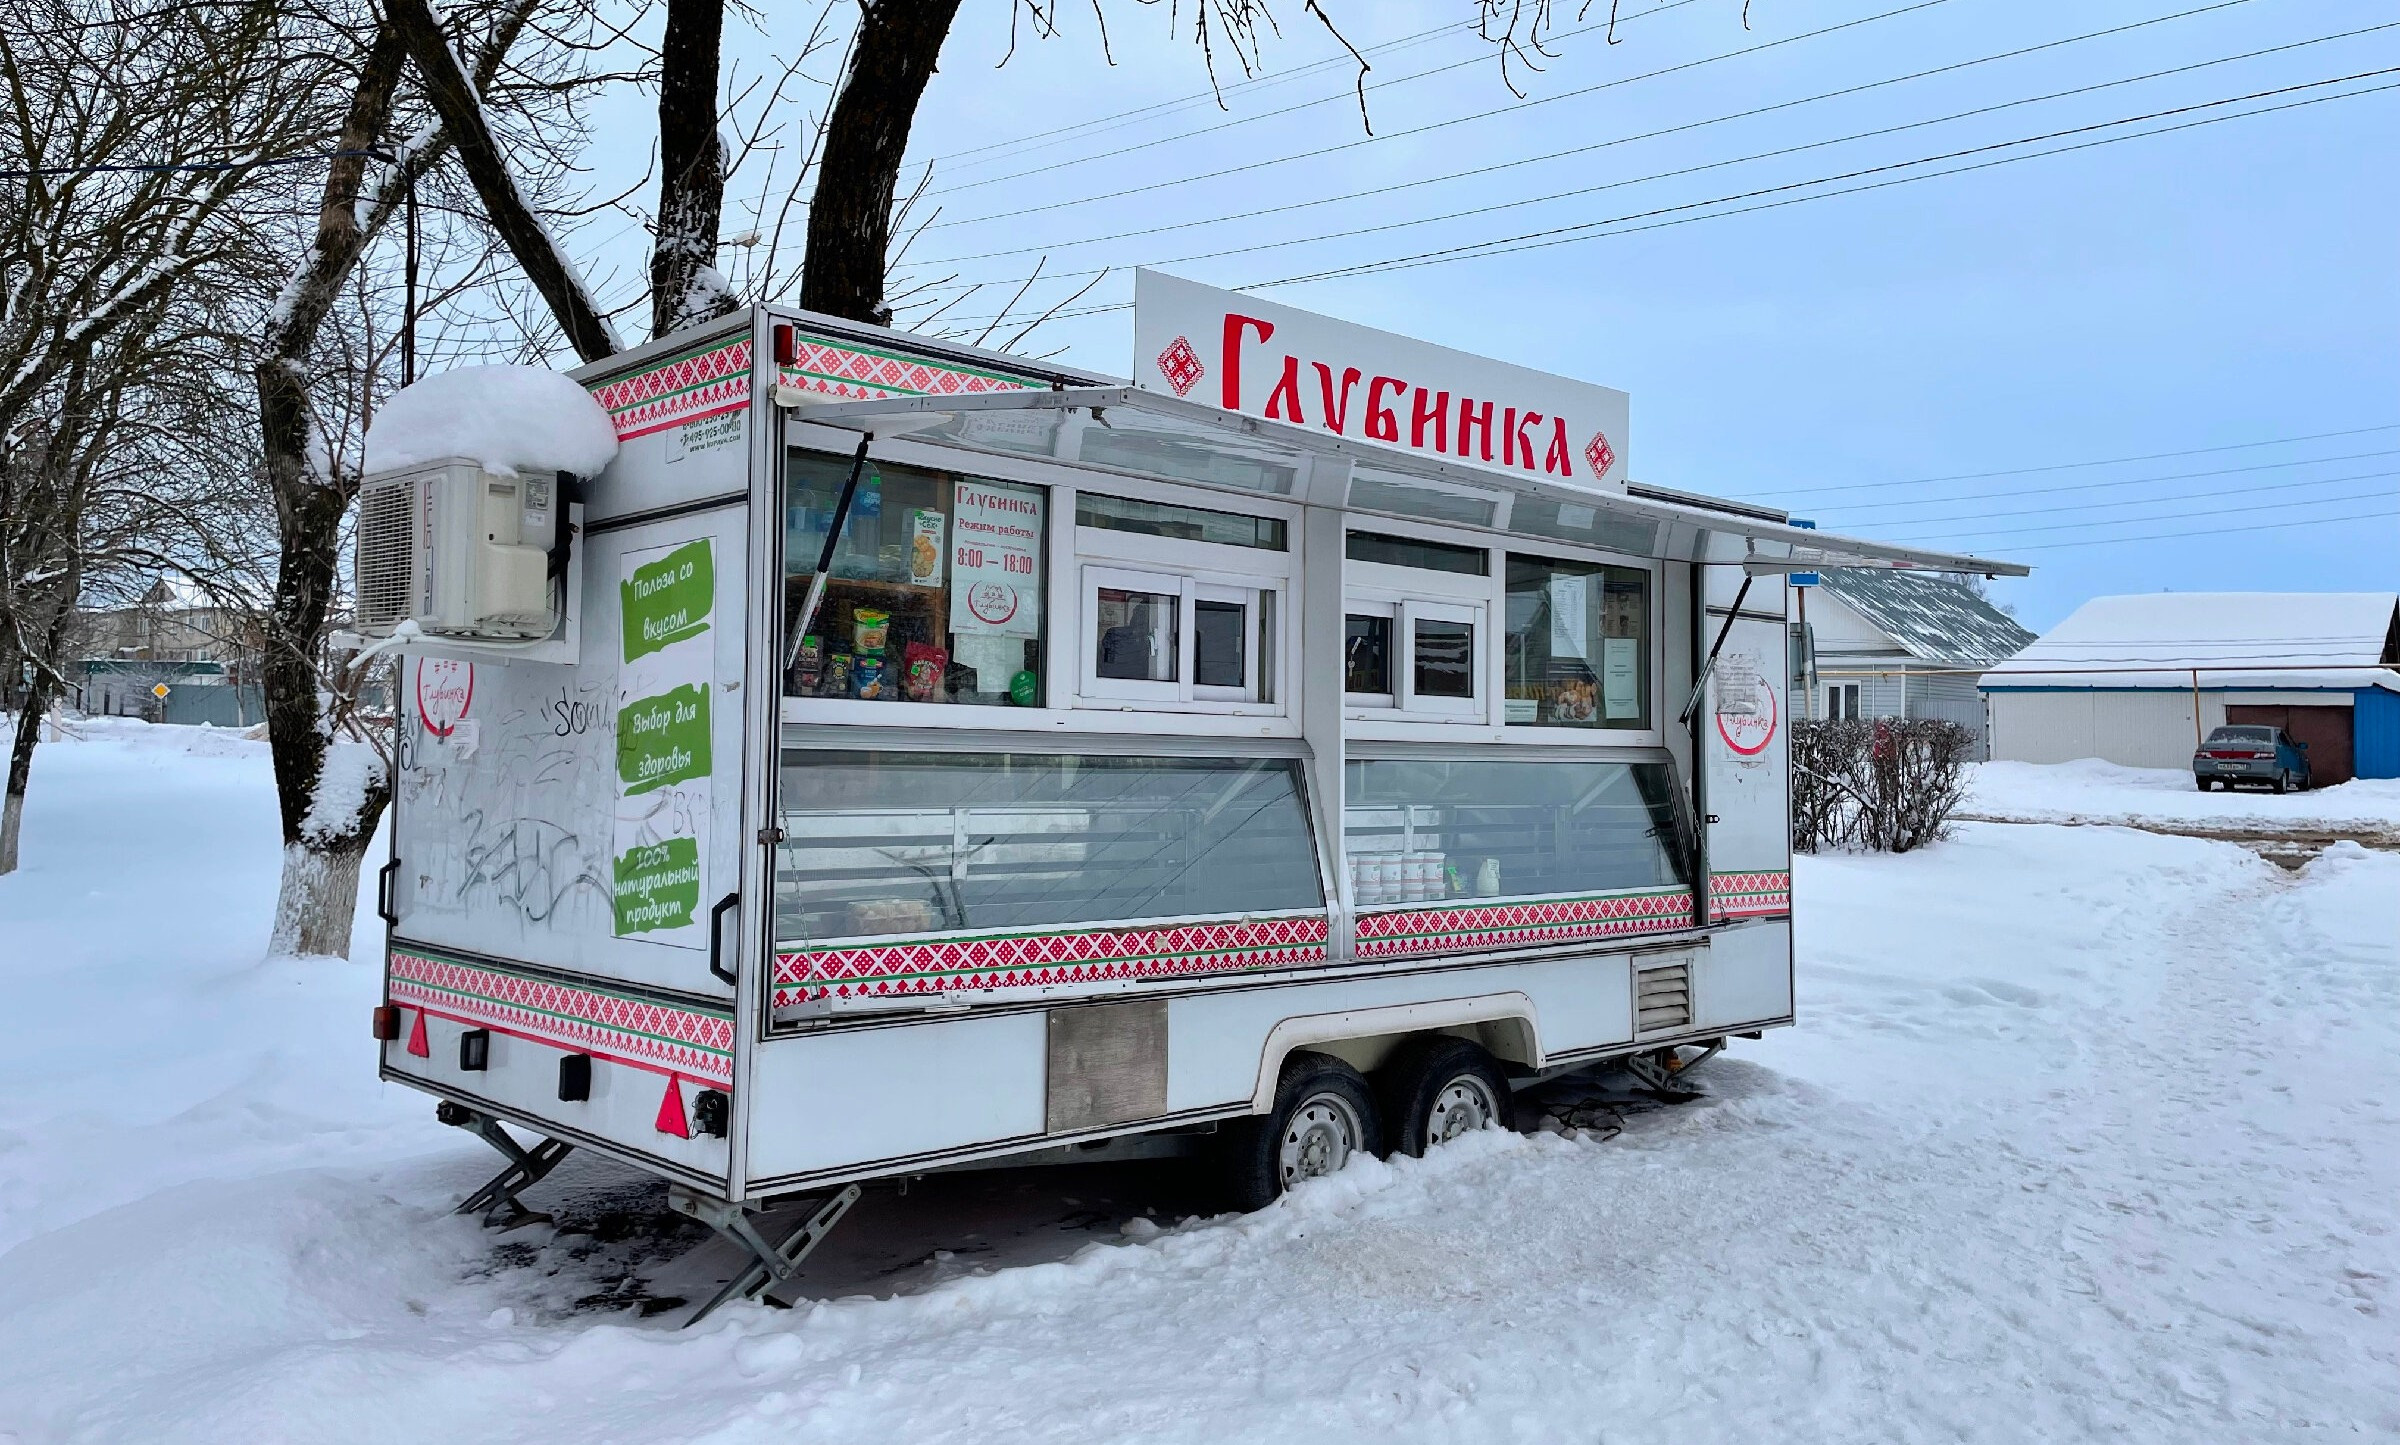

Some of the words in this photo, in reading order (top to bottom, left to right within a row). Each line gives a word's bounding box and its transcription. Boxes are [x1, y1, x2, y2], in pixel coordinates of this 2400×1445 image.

[958, 518, 996, 533] Режим
[998, 525, 1034, 538] работы
[957, 547, 983, 568] 8:00
[1003, 554, 1033, 575] 18:00
[634, 569, 675, 601] Польза
[680, 562, 693, 580] со
[643, 608, 687, 640] вкусом
[633, 705, 670, 735] Выбор
[675, 701, 696, 723] для
[638, 746, 691, 780] здоровья
[636, 845, 670, 870] 100%
[614, 858, 699, 899] натуральный
[626, 897, 682, 930] продукт
